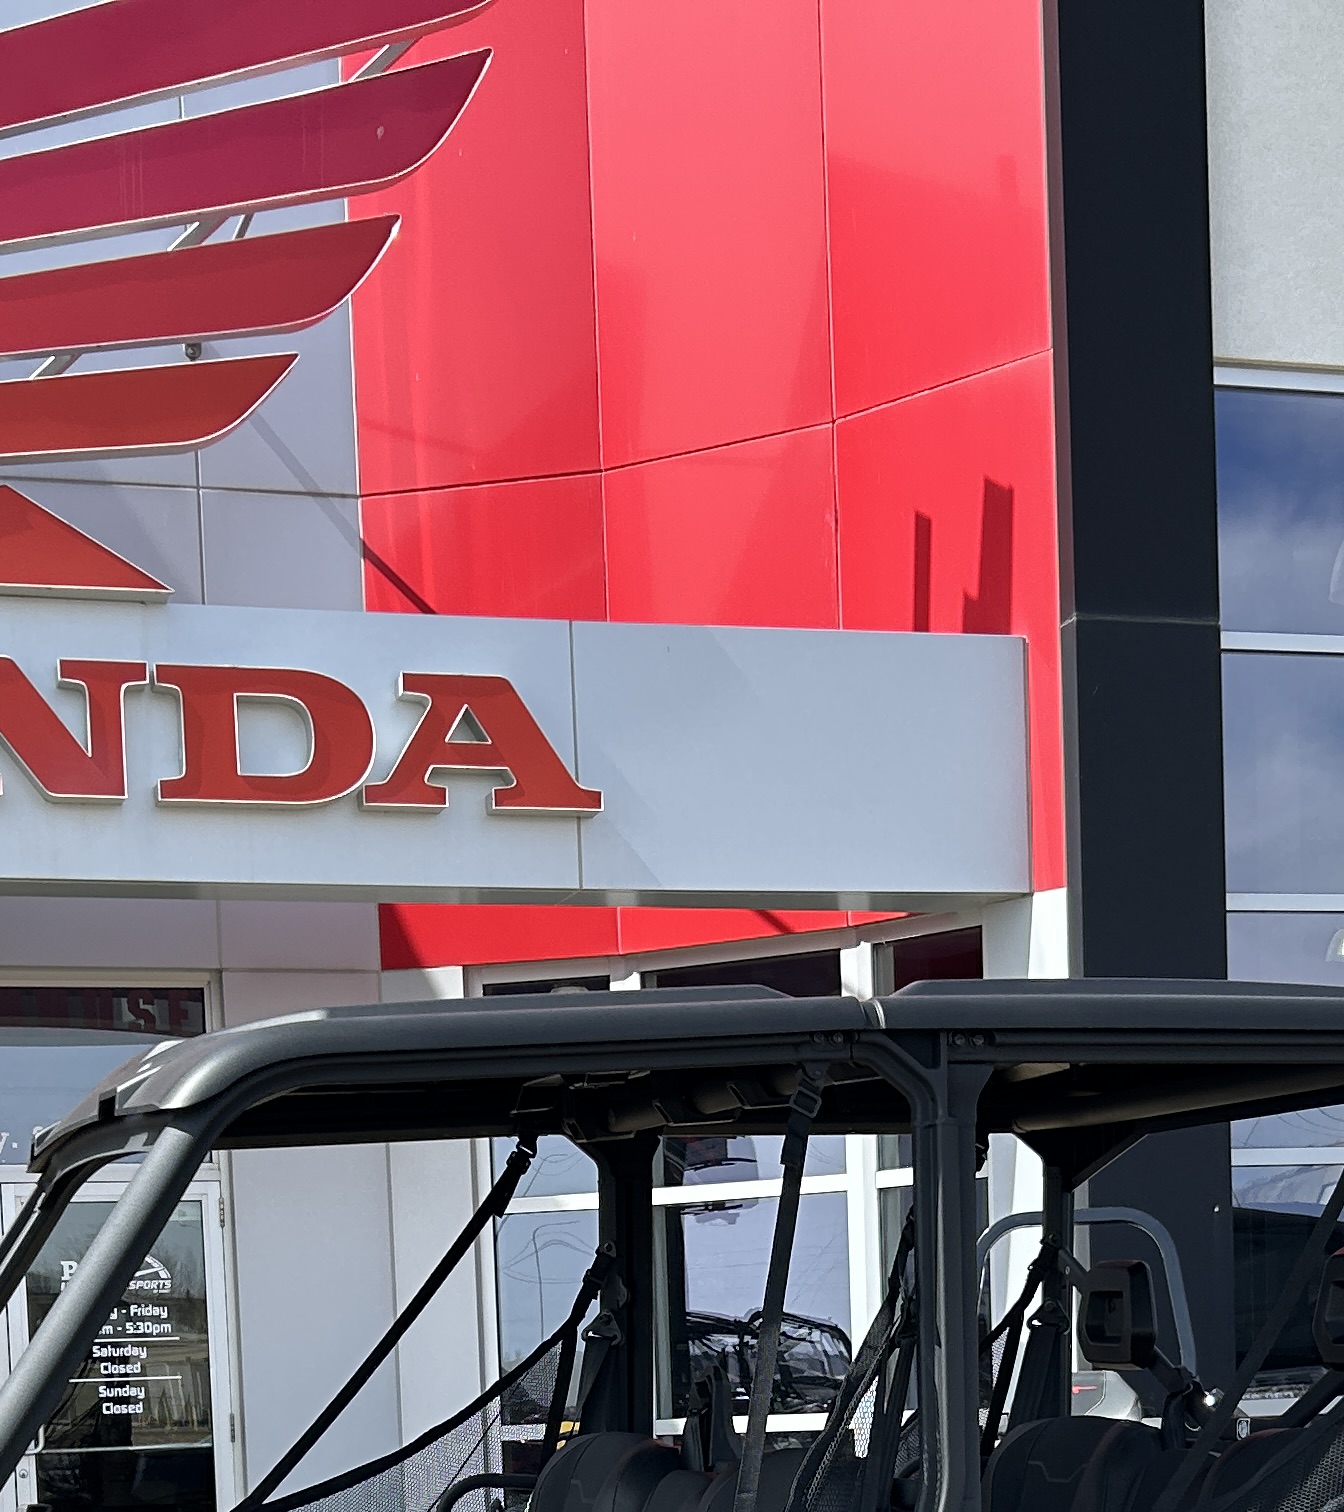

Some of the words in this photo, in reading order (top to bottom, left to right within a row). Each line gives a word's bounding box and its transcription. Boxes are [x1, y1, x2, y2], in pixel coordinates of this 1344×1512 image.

[130, 1304, 168, 1319] Friday
[125, 1322, 172, 1335] 5:30pm
[92, 1344, 147, 1359] Saturday
[100, 1362, 142, 1374] Closed
[98, 1385, 145, 1399] Sunday
[102, 1402, 144, 1415] Closed
